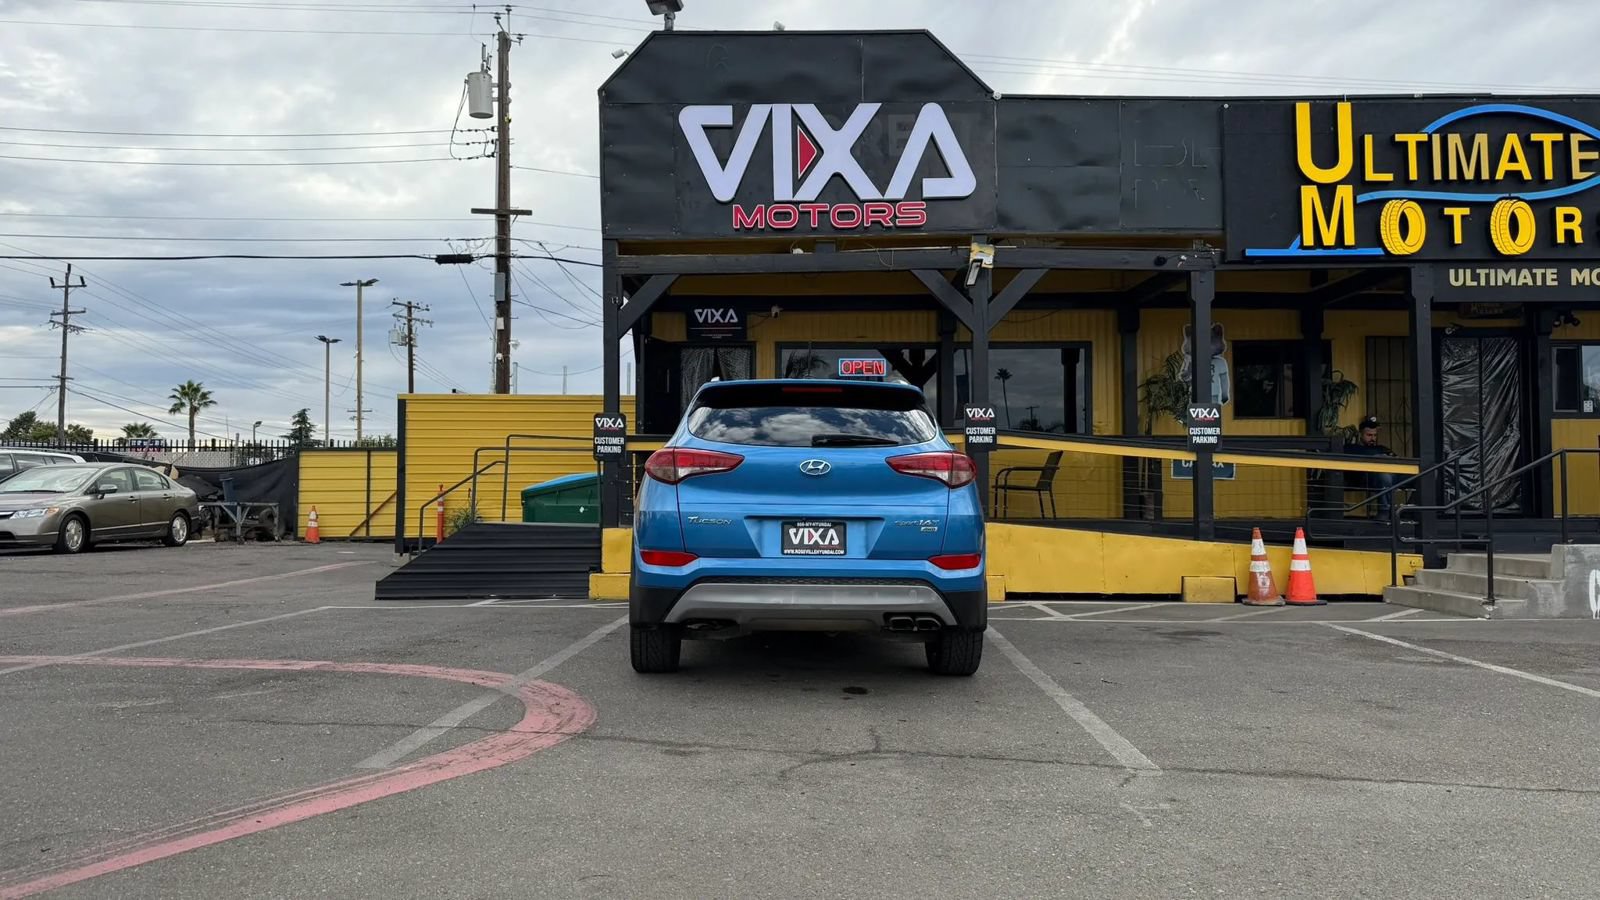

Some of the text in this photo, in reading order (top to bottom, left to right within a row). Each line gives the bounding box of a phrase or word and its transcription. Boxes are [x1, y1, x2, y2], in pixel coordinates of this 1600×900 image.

[1295, 101, 1599, 184] ULTIMATE
[679, 103, 977, 201] VIXA
[732, 202, 928, 230] MOTORS
[1449, 268, 1559, 287] ULTIMATE
[694, 308, 738, 323] VIXA
[841, 360, 885, 375] OPEN
[965, 407, 996, 418] VIXA
[1189, 408, 1219, 418] VIXA
[595, 418, 624, 428] VIXA
[965, 426, 996, 435] CUSTOMER
[1189, 427, 1221, 435] CUSTOMER
[968, 435, 994, 444] PARKING
[1192, 435, 1218, 444] PARKING
[788, 527, 840, 546] VIXA
